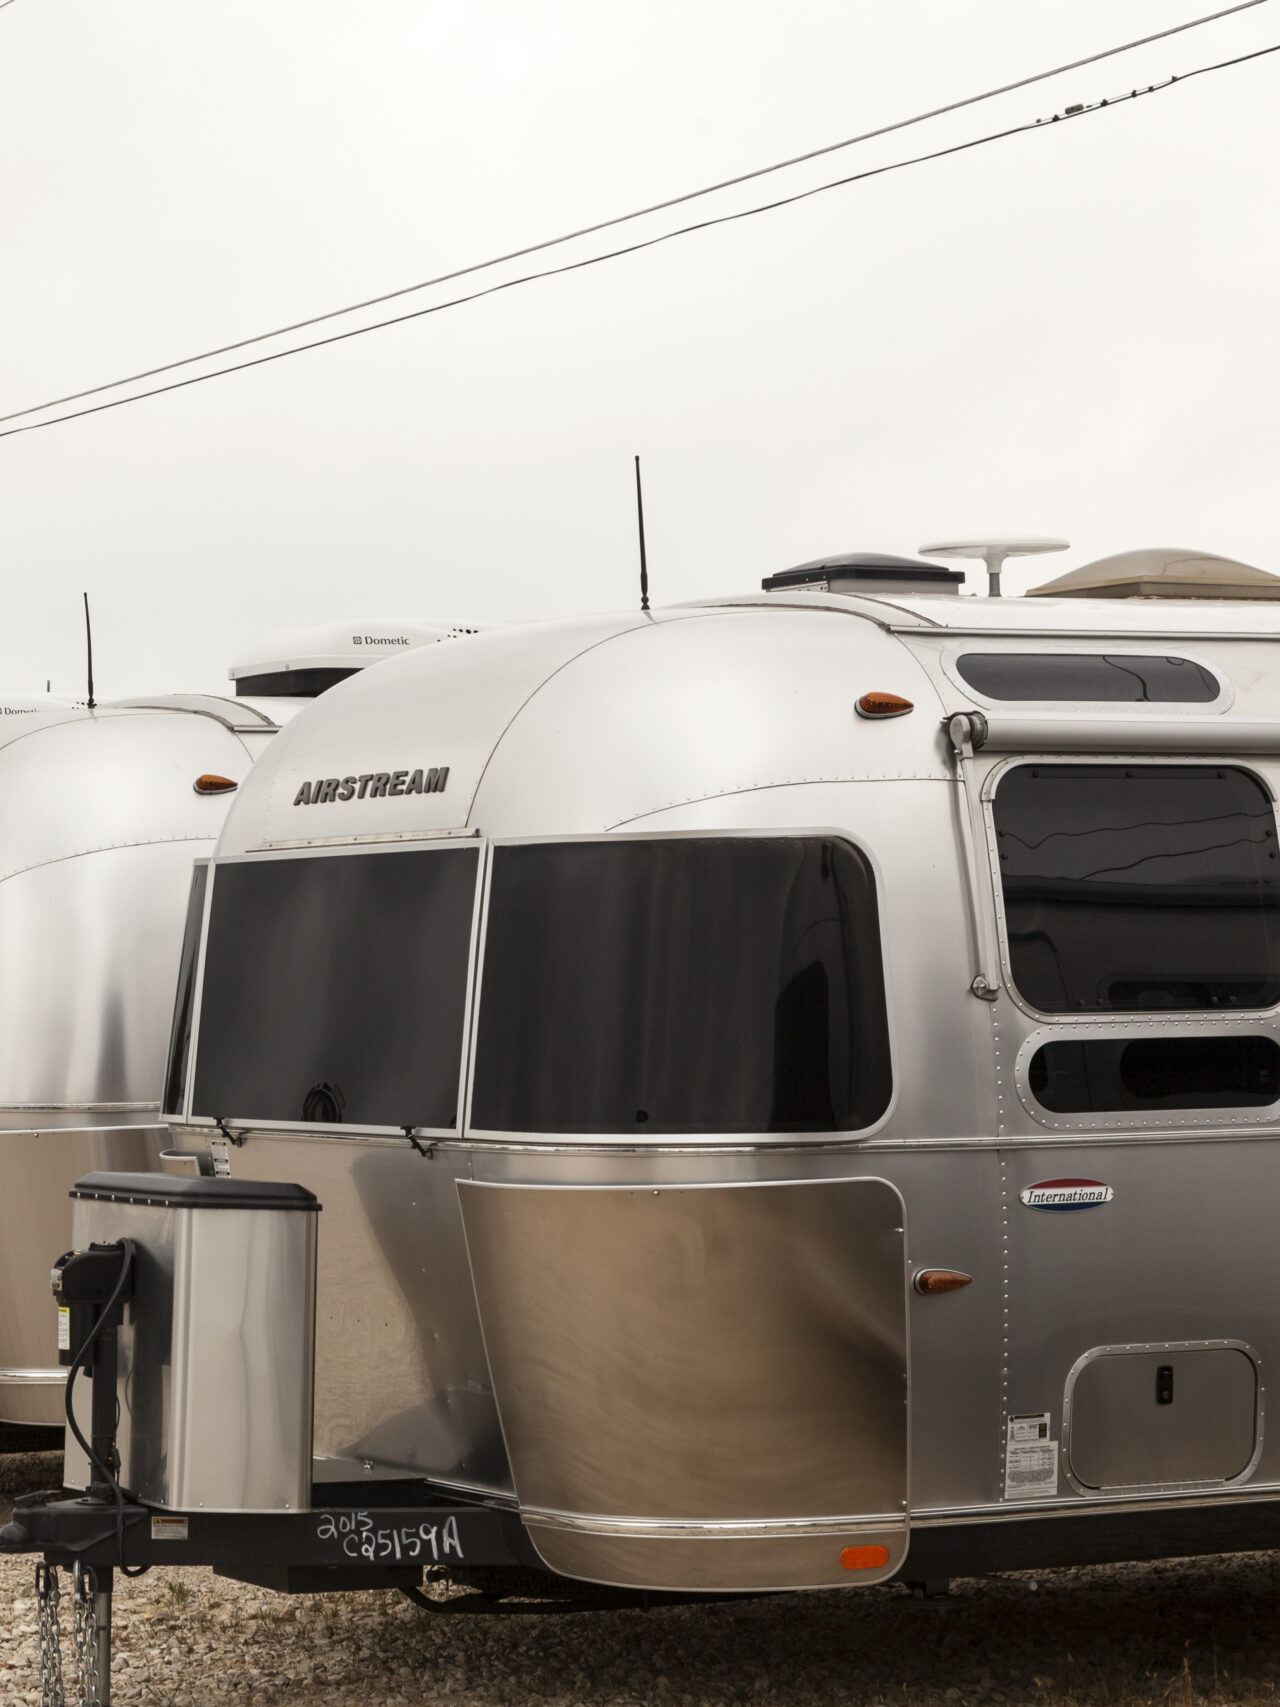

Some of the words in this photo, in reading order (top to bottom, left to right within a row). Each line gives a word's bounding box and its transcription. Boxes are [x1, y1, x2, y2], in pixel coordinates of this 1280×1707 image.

[364, 636, 410, 645] Dometic
[293, 767, 450, 806] AIRSTREAM
[1026, 1187, 1109, 1204] International
[317, 1511, 373, 1539] 2015
